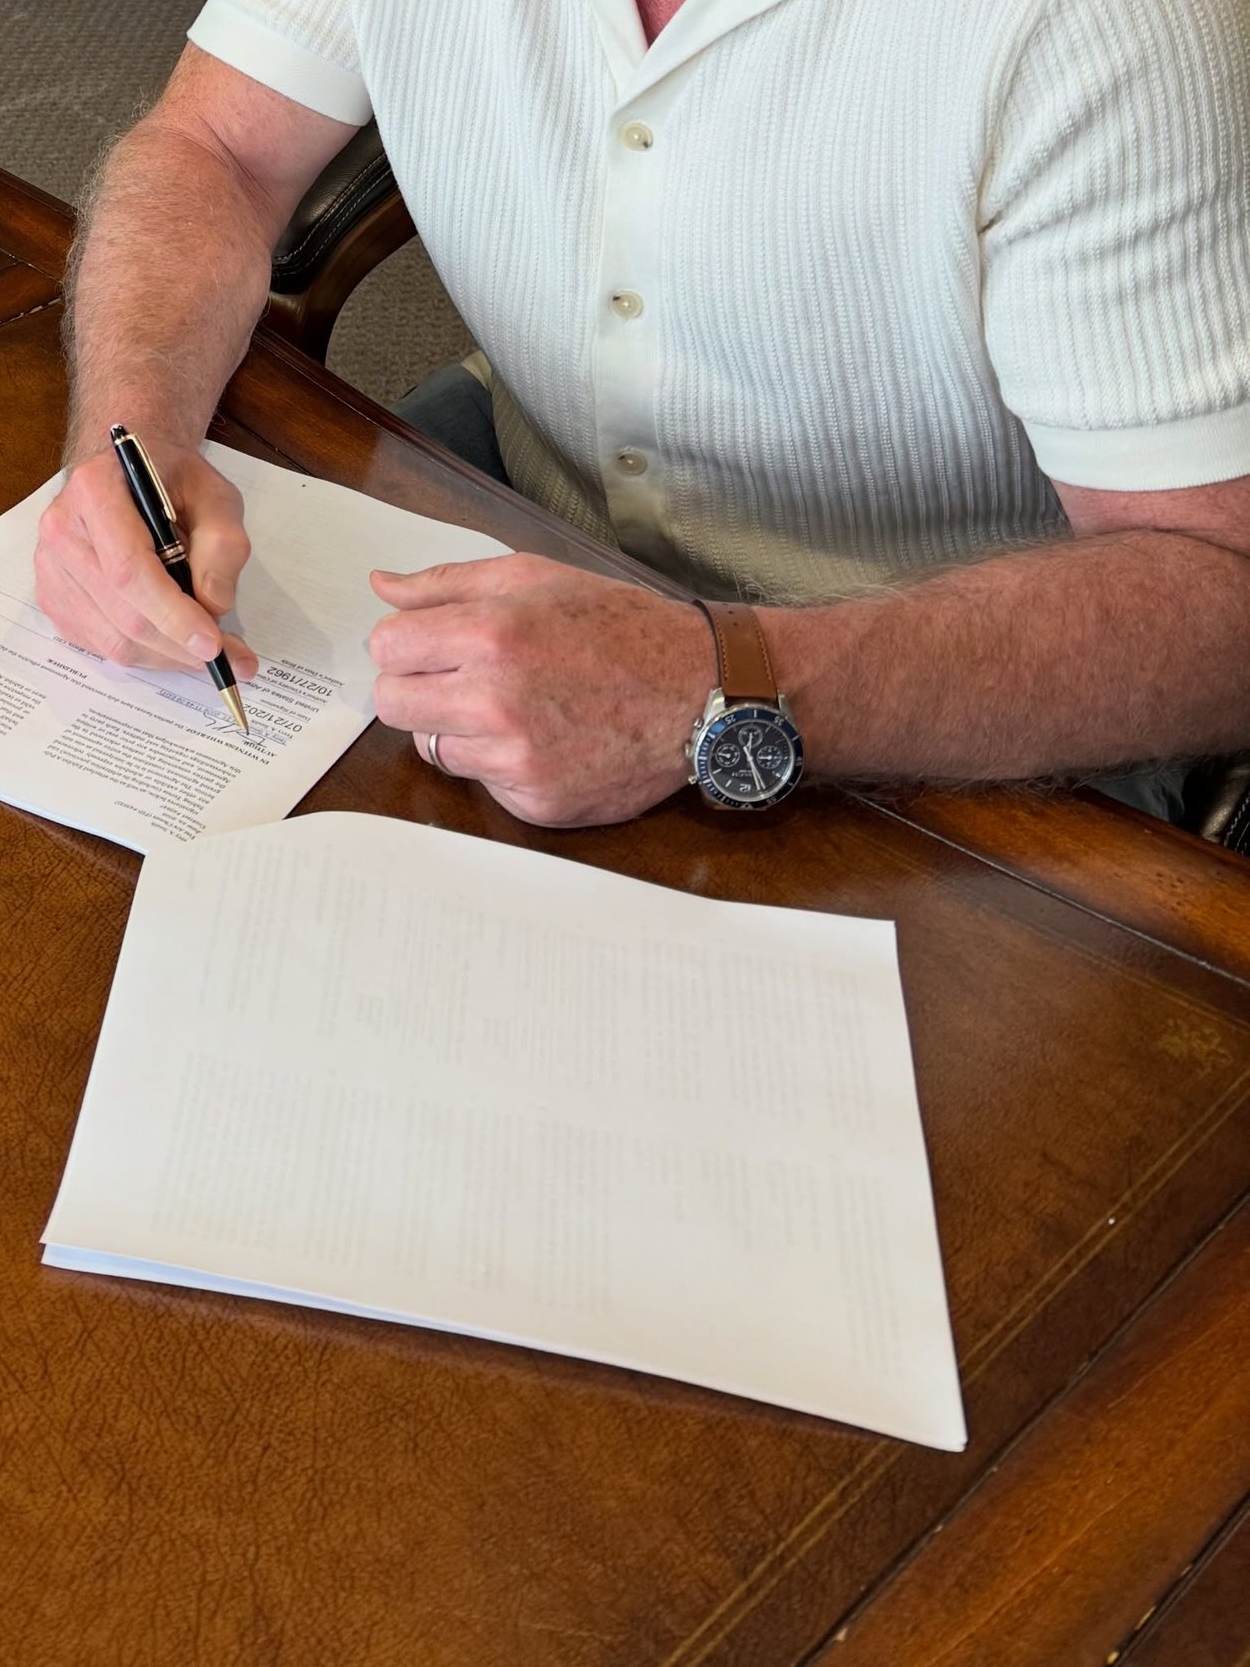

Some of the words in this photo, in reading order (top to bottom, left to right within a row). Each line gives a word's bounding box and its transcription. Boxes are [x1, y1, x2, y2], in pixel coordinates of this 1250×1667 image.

[265, 663, 334, 699] 10/27/1962
[238, 700, 303, 734] 07/21/202
[222, 741, 260, 761] WITNESS
